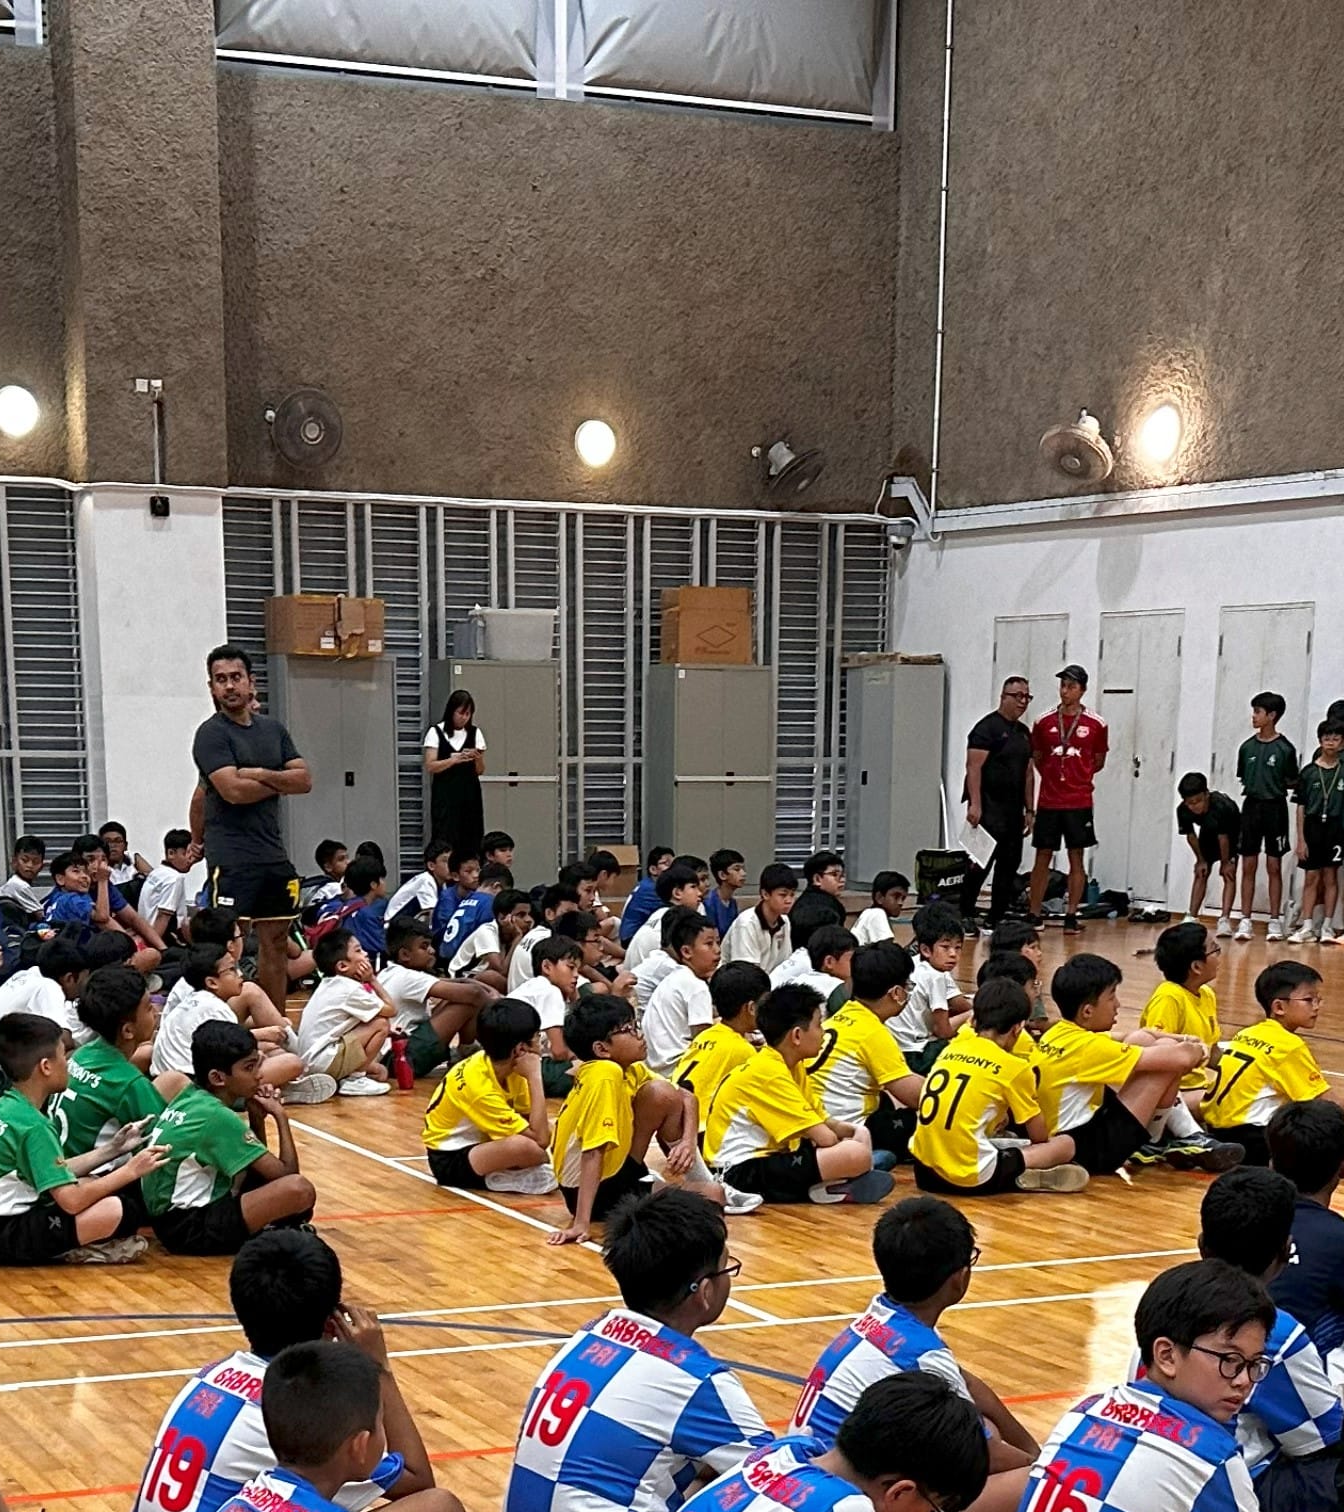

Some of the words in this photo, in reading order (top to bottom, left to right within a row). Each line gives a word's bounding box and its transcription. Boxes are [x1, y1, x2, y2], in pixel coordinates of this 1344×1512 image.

[1332, 845, 1342, 862] 2
[443, 909, 465, 943] 5
[919, 1068, 972, 1131] 81
[526, 1370, 591, 1447] 19
[146, 1427, 205, 1512] 19
